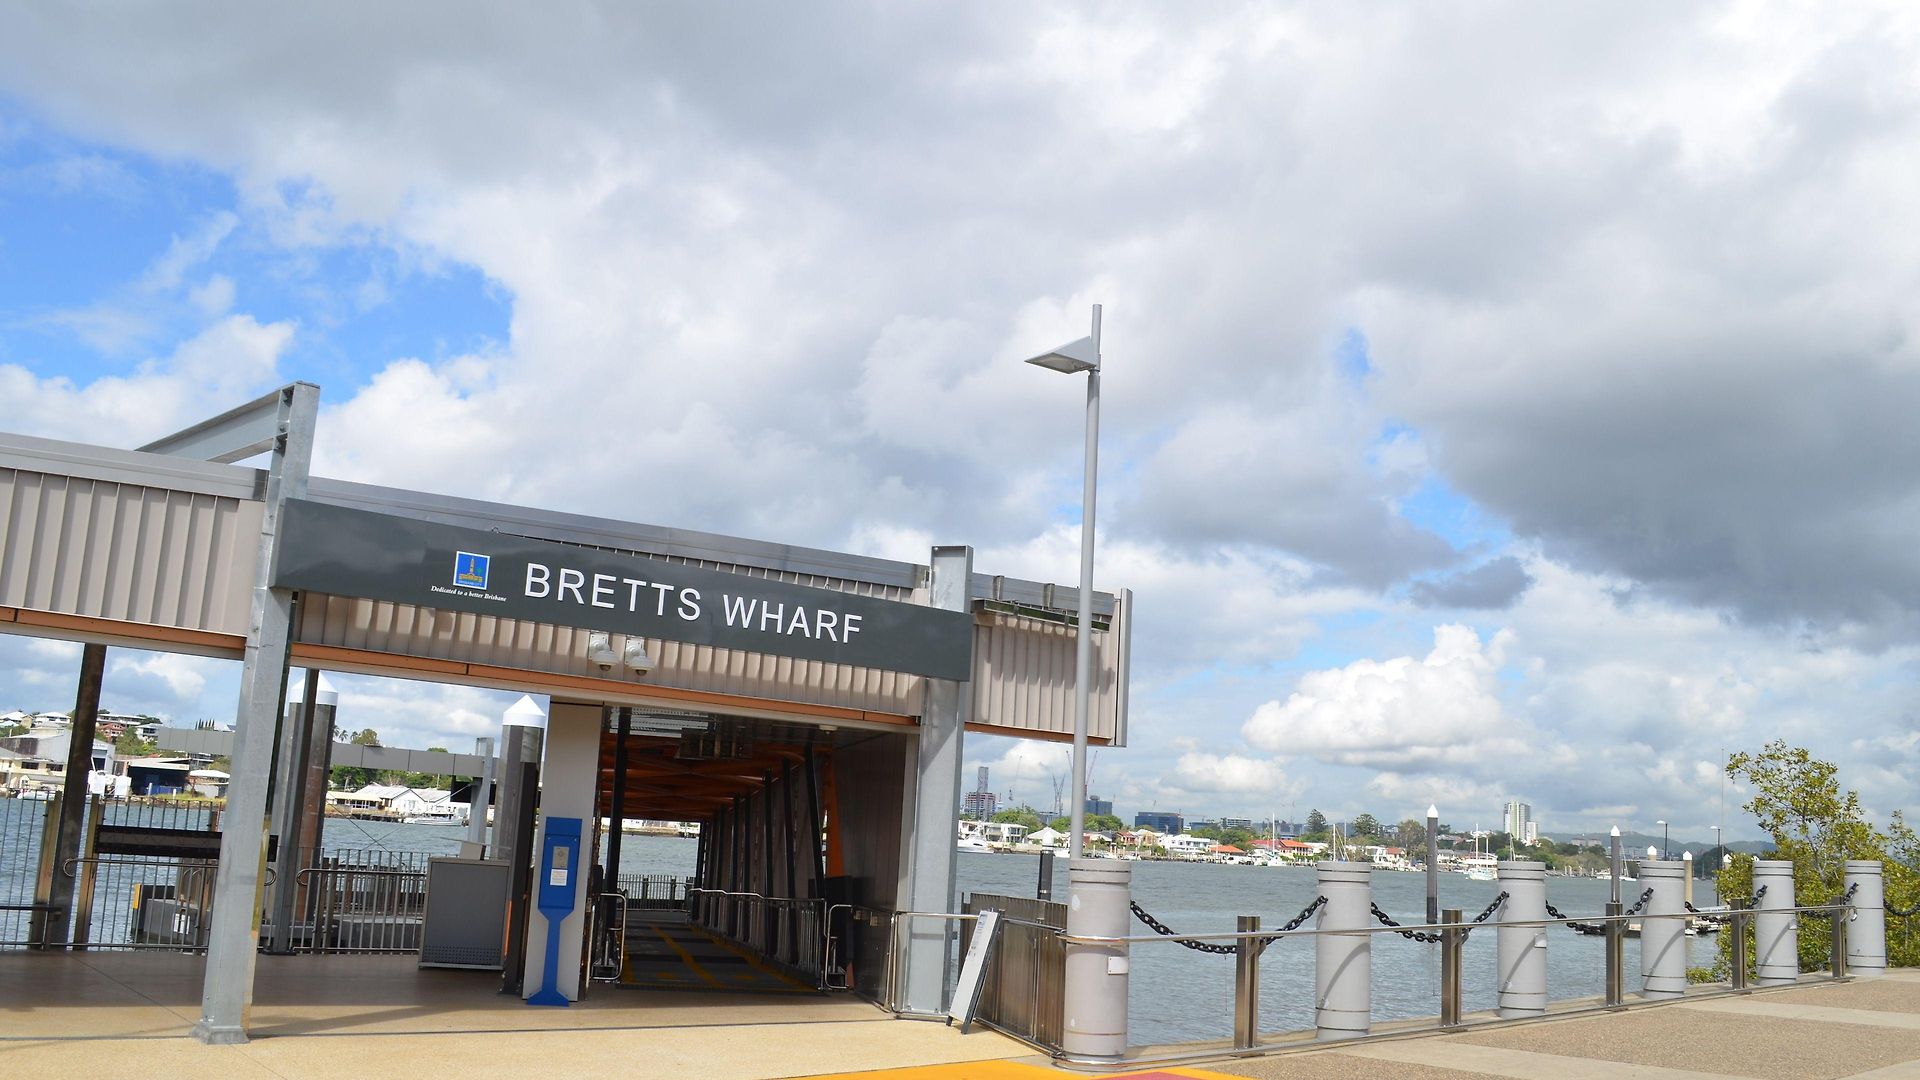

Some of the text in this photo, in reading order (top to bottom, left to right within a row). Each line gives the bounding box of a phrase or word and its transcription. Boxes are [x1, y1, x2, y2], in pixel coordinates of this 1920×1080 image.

[431, 585, 457, 595] Dedicated
[468, 591, 483, 599] better
[484, 593, 507, 602] Brisbane
[524, 563, 863, 644] BRETTS WHARF
